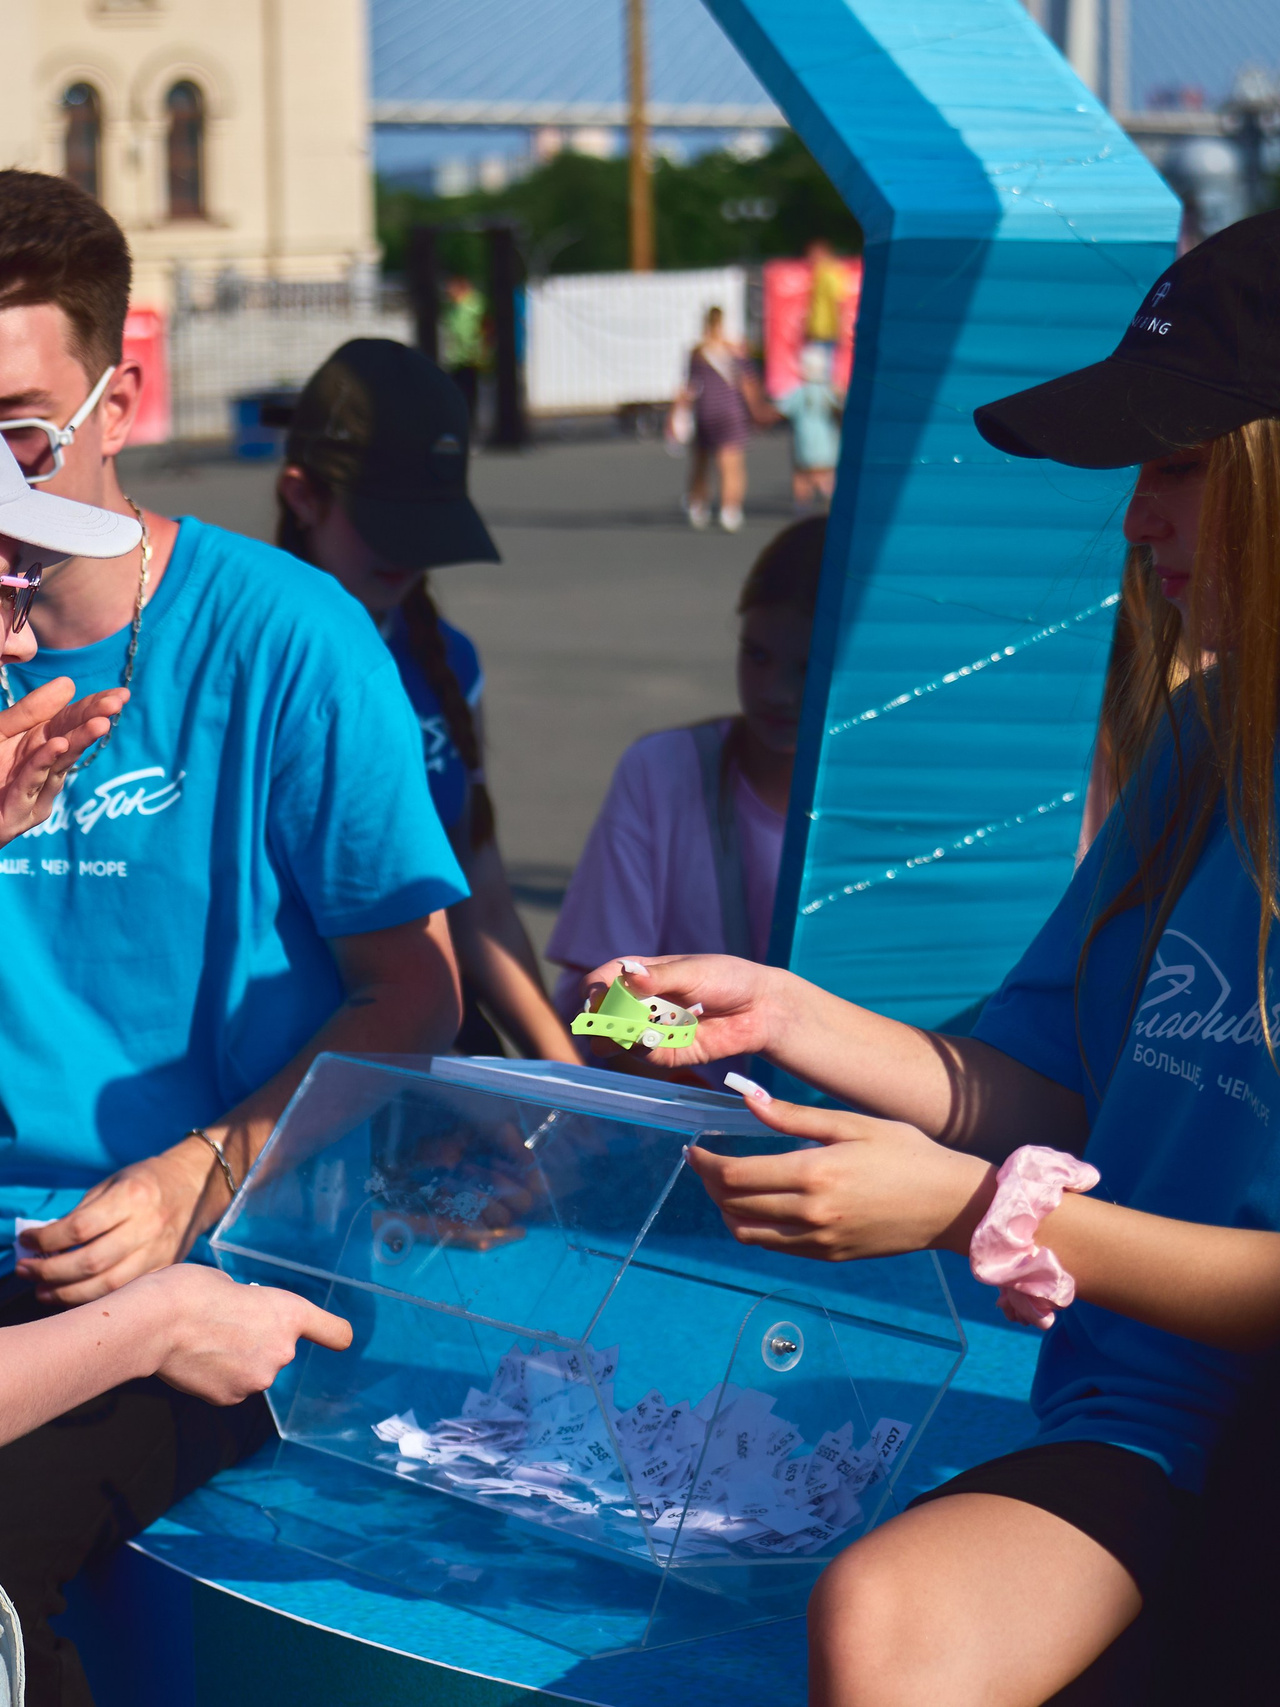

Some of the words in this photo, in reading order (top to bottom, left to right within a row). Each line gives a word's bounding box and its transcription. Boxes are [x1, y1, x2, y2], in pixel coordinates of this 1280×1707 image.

[79, 861, 127, 877] МОРЕ
[1133, 1043, 1205, 1092] БОЛЬШЕ,
[556, 1423, 584, 1435] 2901
[880, 1426, 900, 1458] 2707
[641, 1460, 668, 1477] 1813
[785, 1463, 798, 1481] 639
